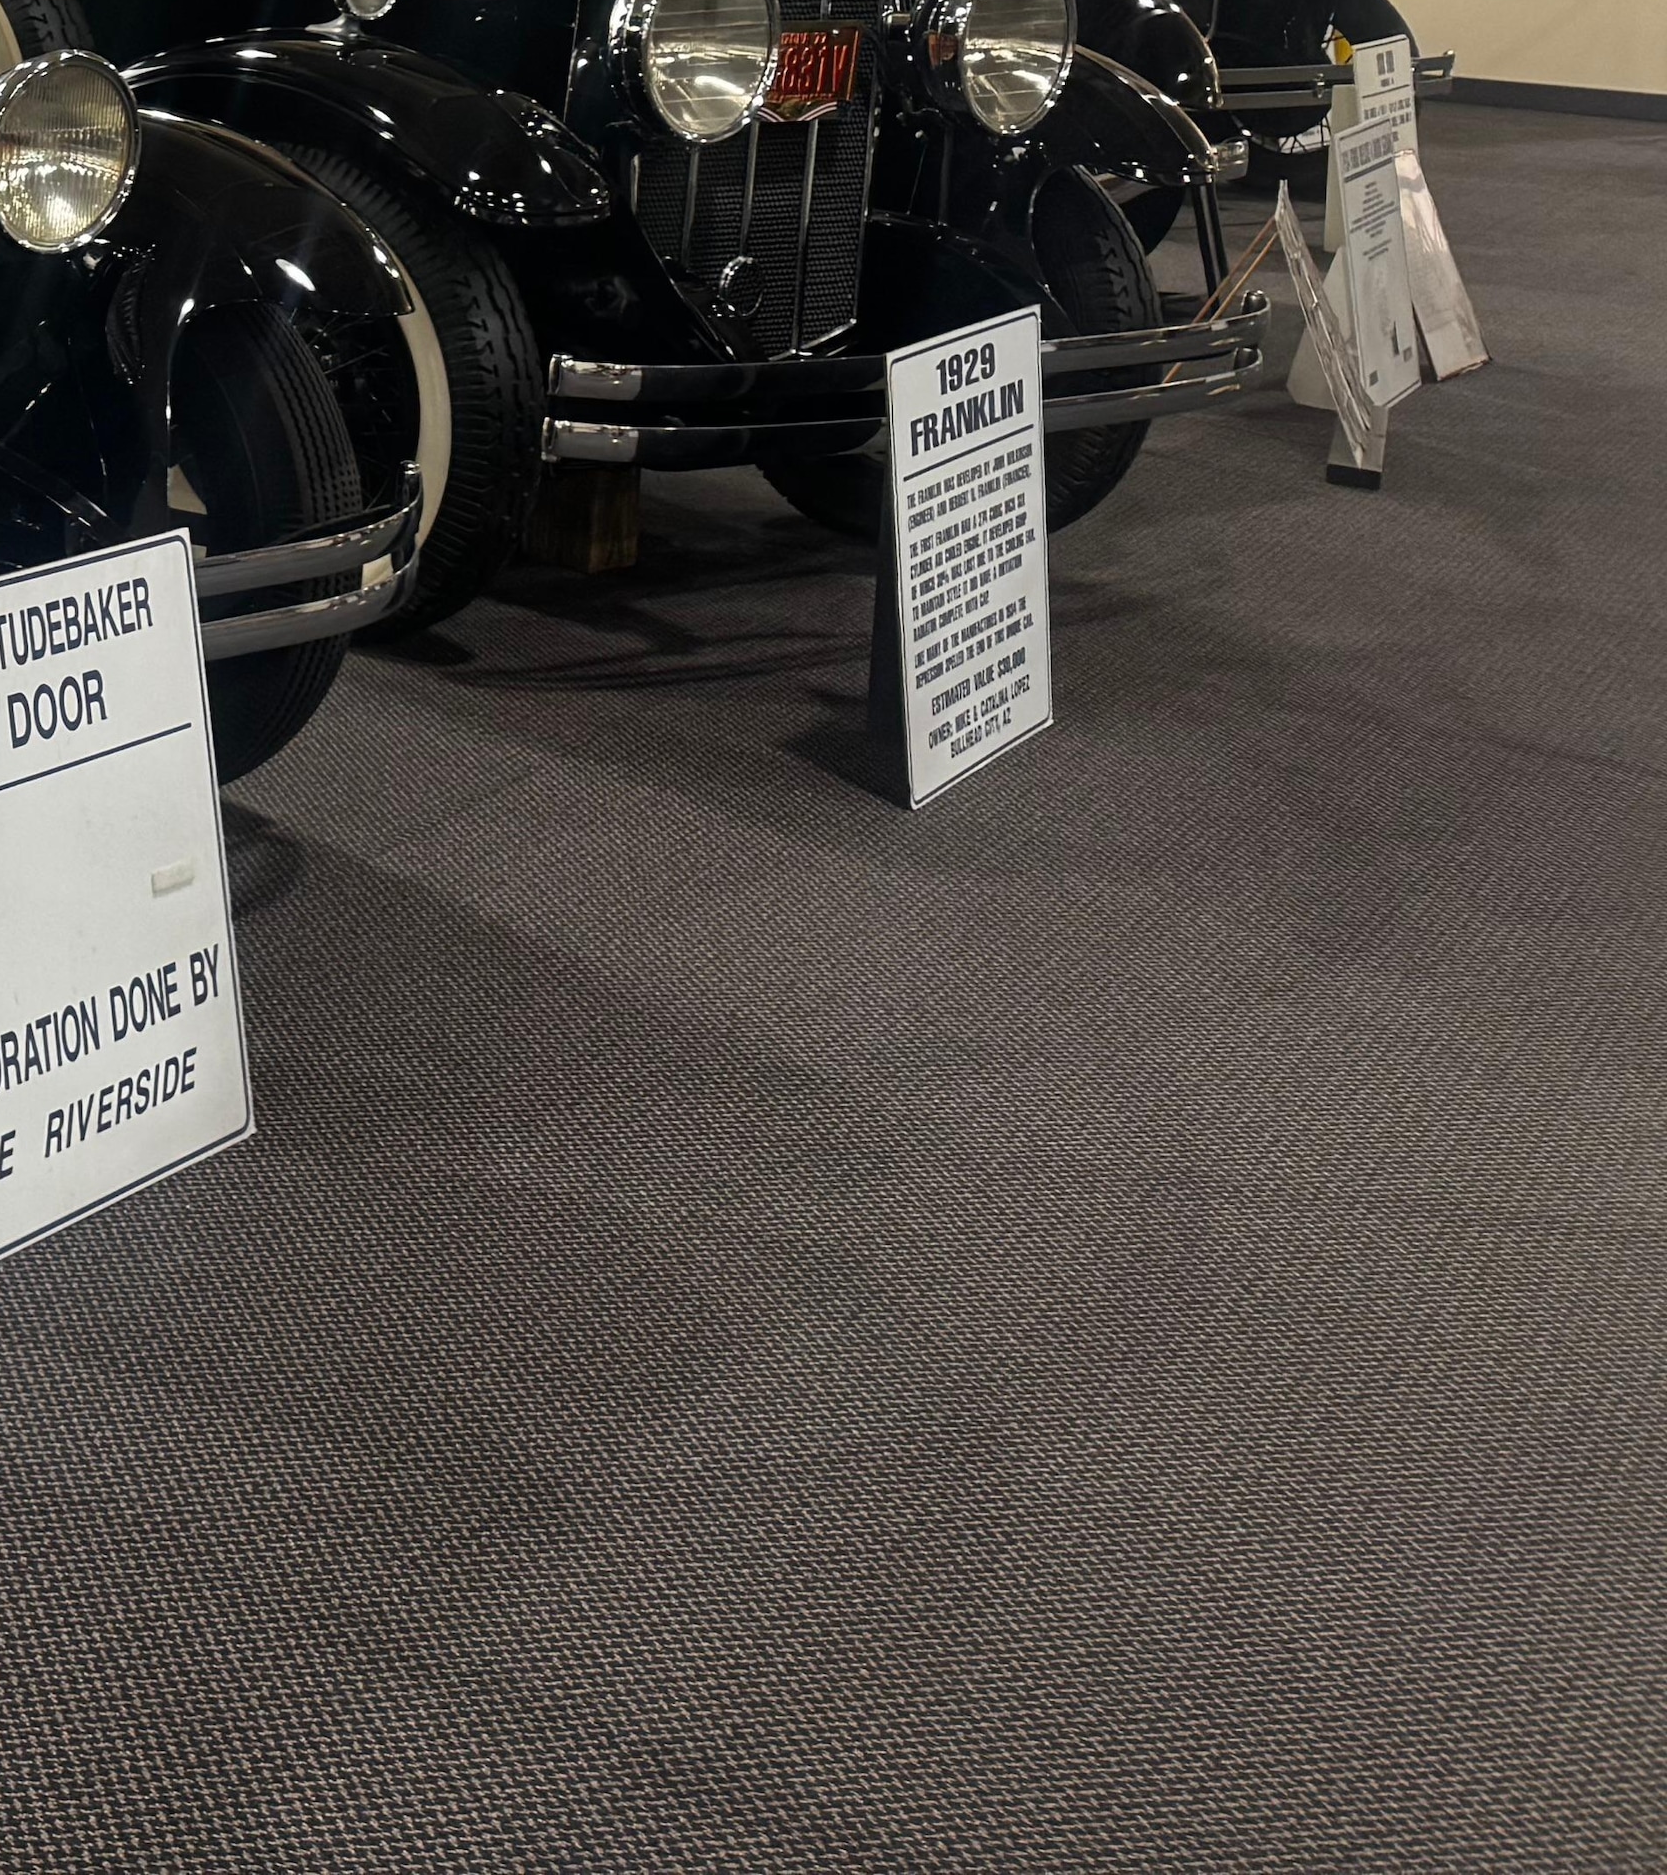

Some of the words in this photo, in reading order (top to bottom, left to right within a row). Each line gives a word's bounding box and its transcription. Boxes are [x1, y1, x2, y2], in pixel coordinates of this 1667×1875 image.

[936, 342, 996, 396] 1929
[910, 379, 1024, 457] FRANKLIN
[8, 669, 108, 750] DOOR
[1011, 674, 1030, 700] LOPEZ
[109, 963, 181, 1041] DONE
[190, 944, 221, 1006] BY
[44, 1047, 198, 1159] RIVERSIDE
